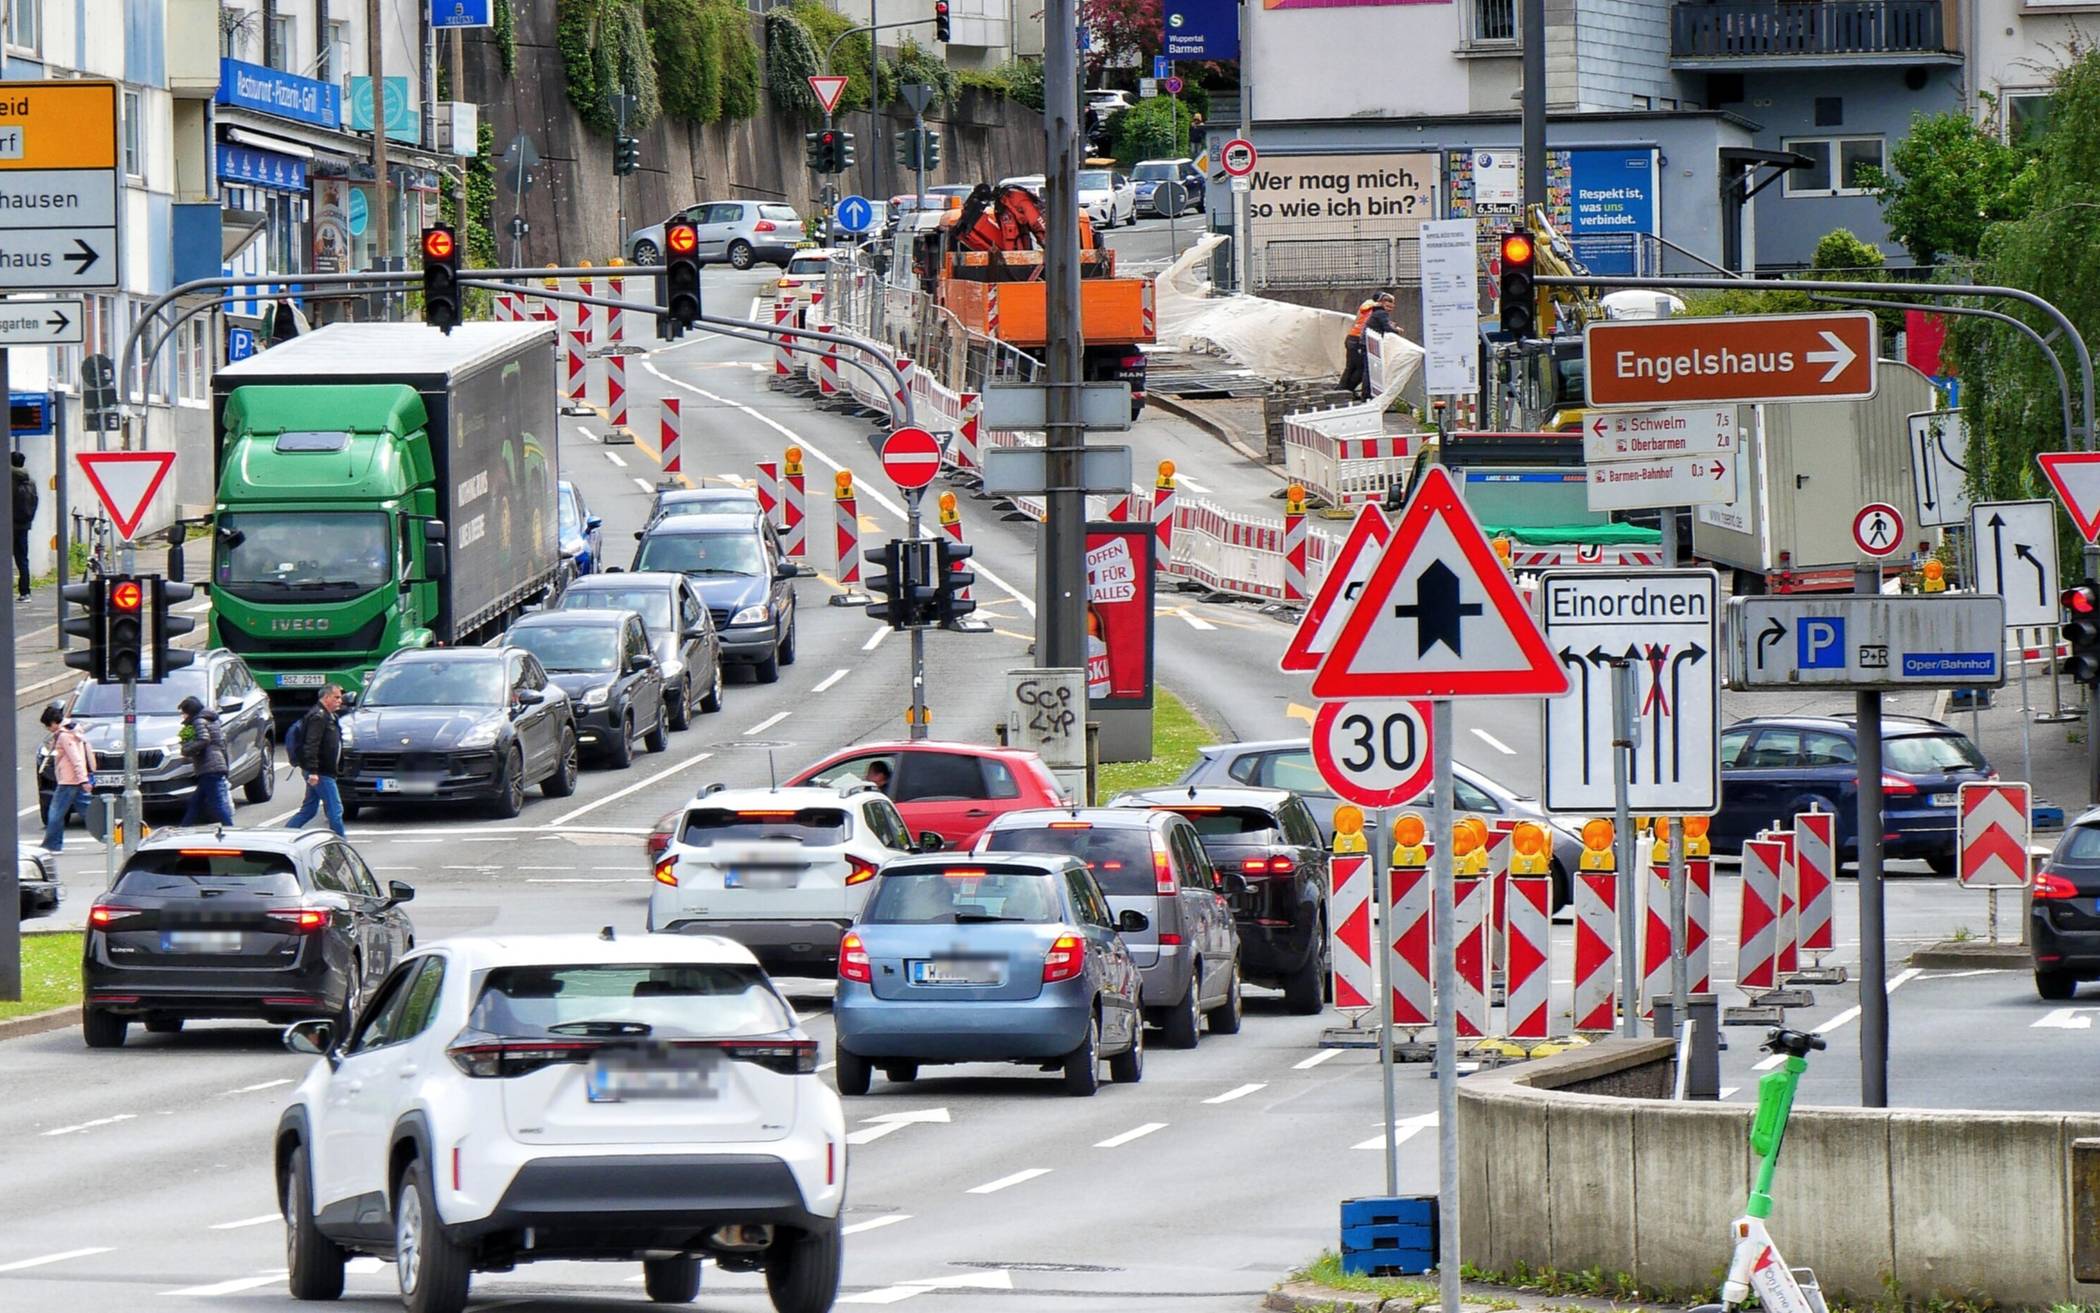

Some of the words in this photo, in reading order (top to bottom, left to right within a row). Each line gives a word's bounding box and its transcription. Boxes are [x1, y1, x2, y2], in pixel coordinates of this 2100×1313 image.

[1169, 35, 1204, 43] Wuppertal
[1169, 44, 1204, 53] Barmen
[1250, 171, 1293, 190] Wer
[1300, 172, 1350, 194] mag
[1357, 168, 1420, 190] mich,
[1580, 188, 1624, 201] Respekt
[1626, 187, 1644, 200] ist,
[1250, 203, 1273, 218] so
[1280, 198, 1321, 217] wie
[1328, 197, 1361, 216] ich
[1580, 203, 1601, 213] was
[1603, 203, 1624, 212] uns
[1580, 214, 1636, 225] verbindet.
[1615, 347, 1795, 384] Engelshaus
[1631, 416, 1686, 431] Schwelm
[1716, 413, 1729, 427] 7,5
[1631, 438, 1686, 451] Oberbarmen
[1717, 434, 1730, 447] 2,0
[1609, 466, 1673, 482] Barmen-Bahnhof
[1691, 463, 1704, 477] 0,3
[1088, 544, 1124, 566] OFFEN
[1102, 565, 1127, 582] FÜR
[1094, 584, 1130, 600] ALLES
[1553, 587, 1705, 617] Einordnen
[272, 618, 329, 631] IVECO
[1808, 622, 1836, 664] P
[1860, 649, 1889, 666] P+R
[1906, 659, 1991, 671] Oper/Bahnhof
[1341, 713, 1416, 772] 30
